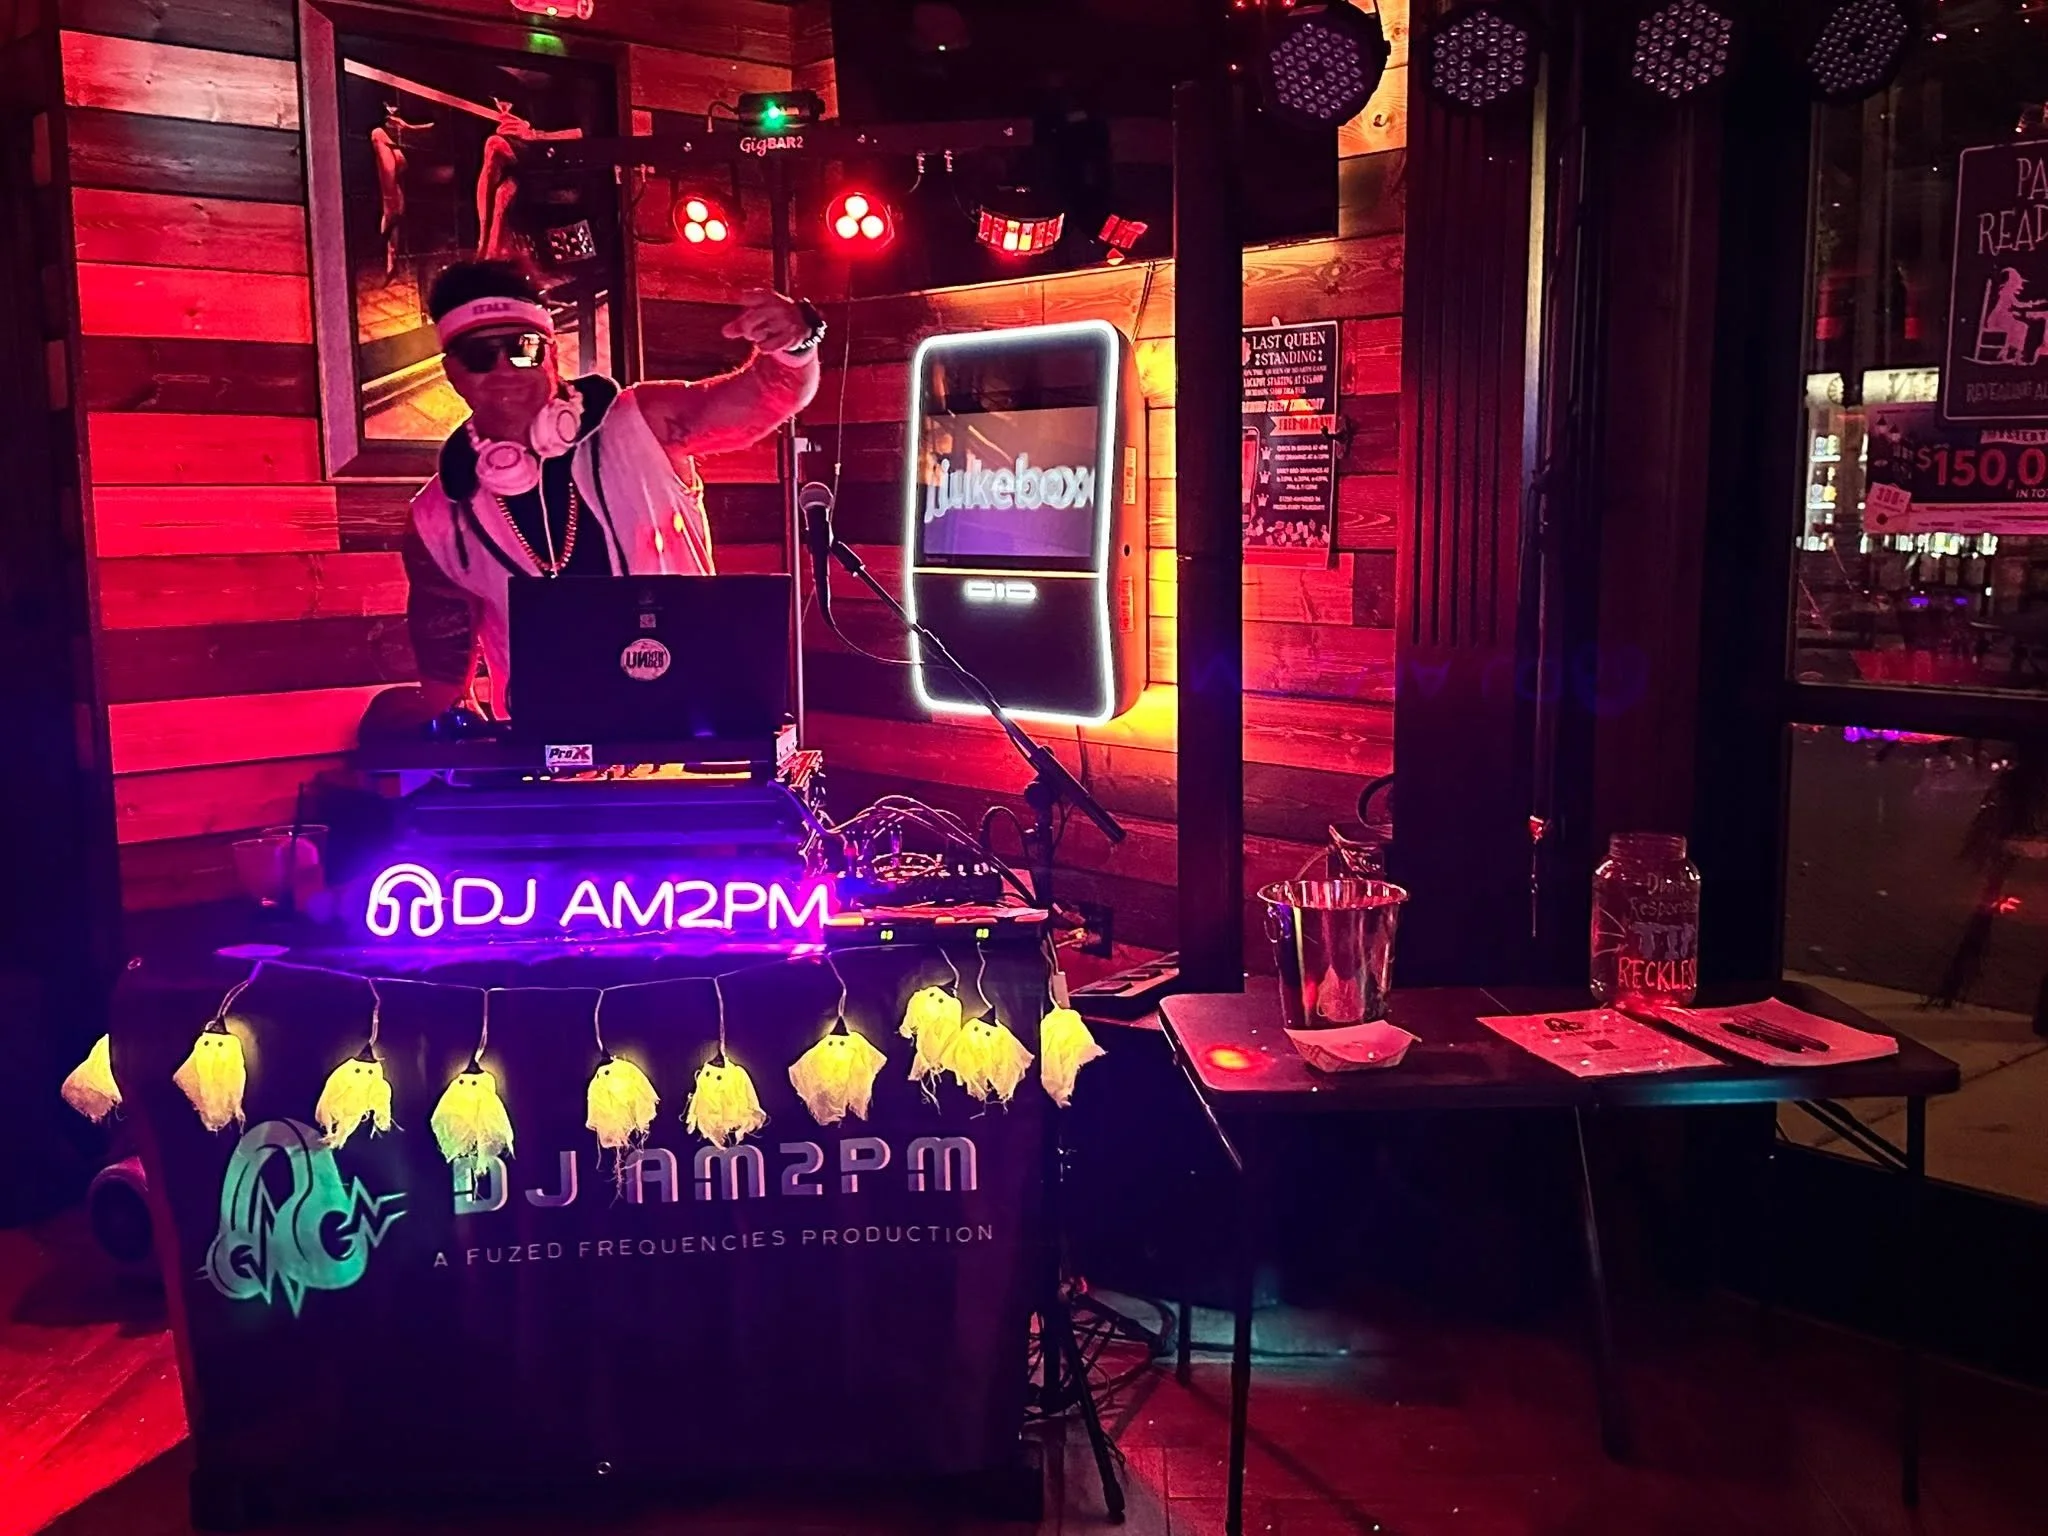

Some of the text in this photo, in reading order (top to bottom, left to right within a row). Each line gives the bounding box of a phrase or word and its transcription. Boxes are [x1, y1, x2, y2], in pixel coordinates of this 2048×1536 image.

[1252, 331, 1326, 350] LAST QUEEN
[1260, 349, 1317, 366] STANDING
[548, 745, 591, 760] ProX
[453, 877, 830, 932] DJ AM2PM
[453, 1136, 977, 1215] DJ AM2PM
[433, 1224, 993, 1268] A FUZED FREQUENCIES PRODUCTION
